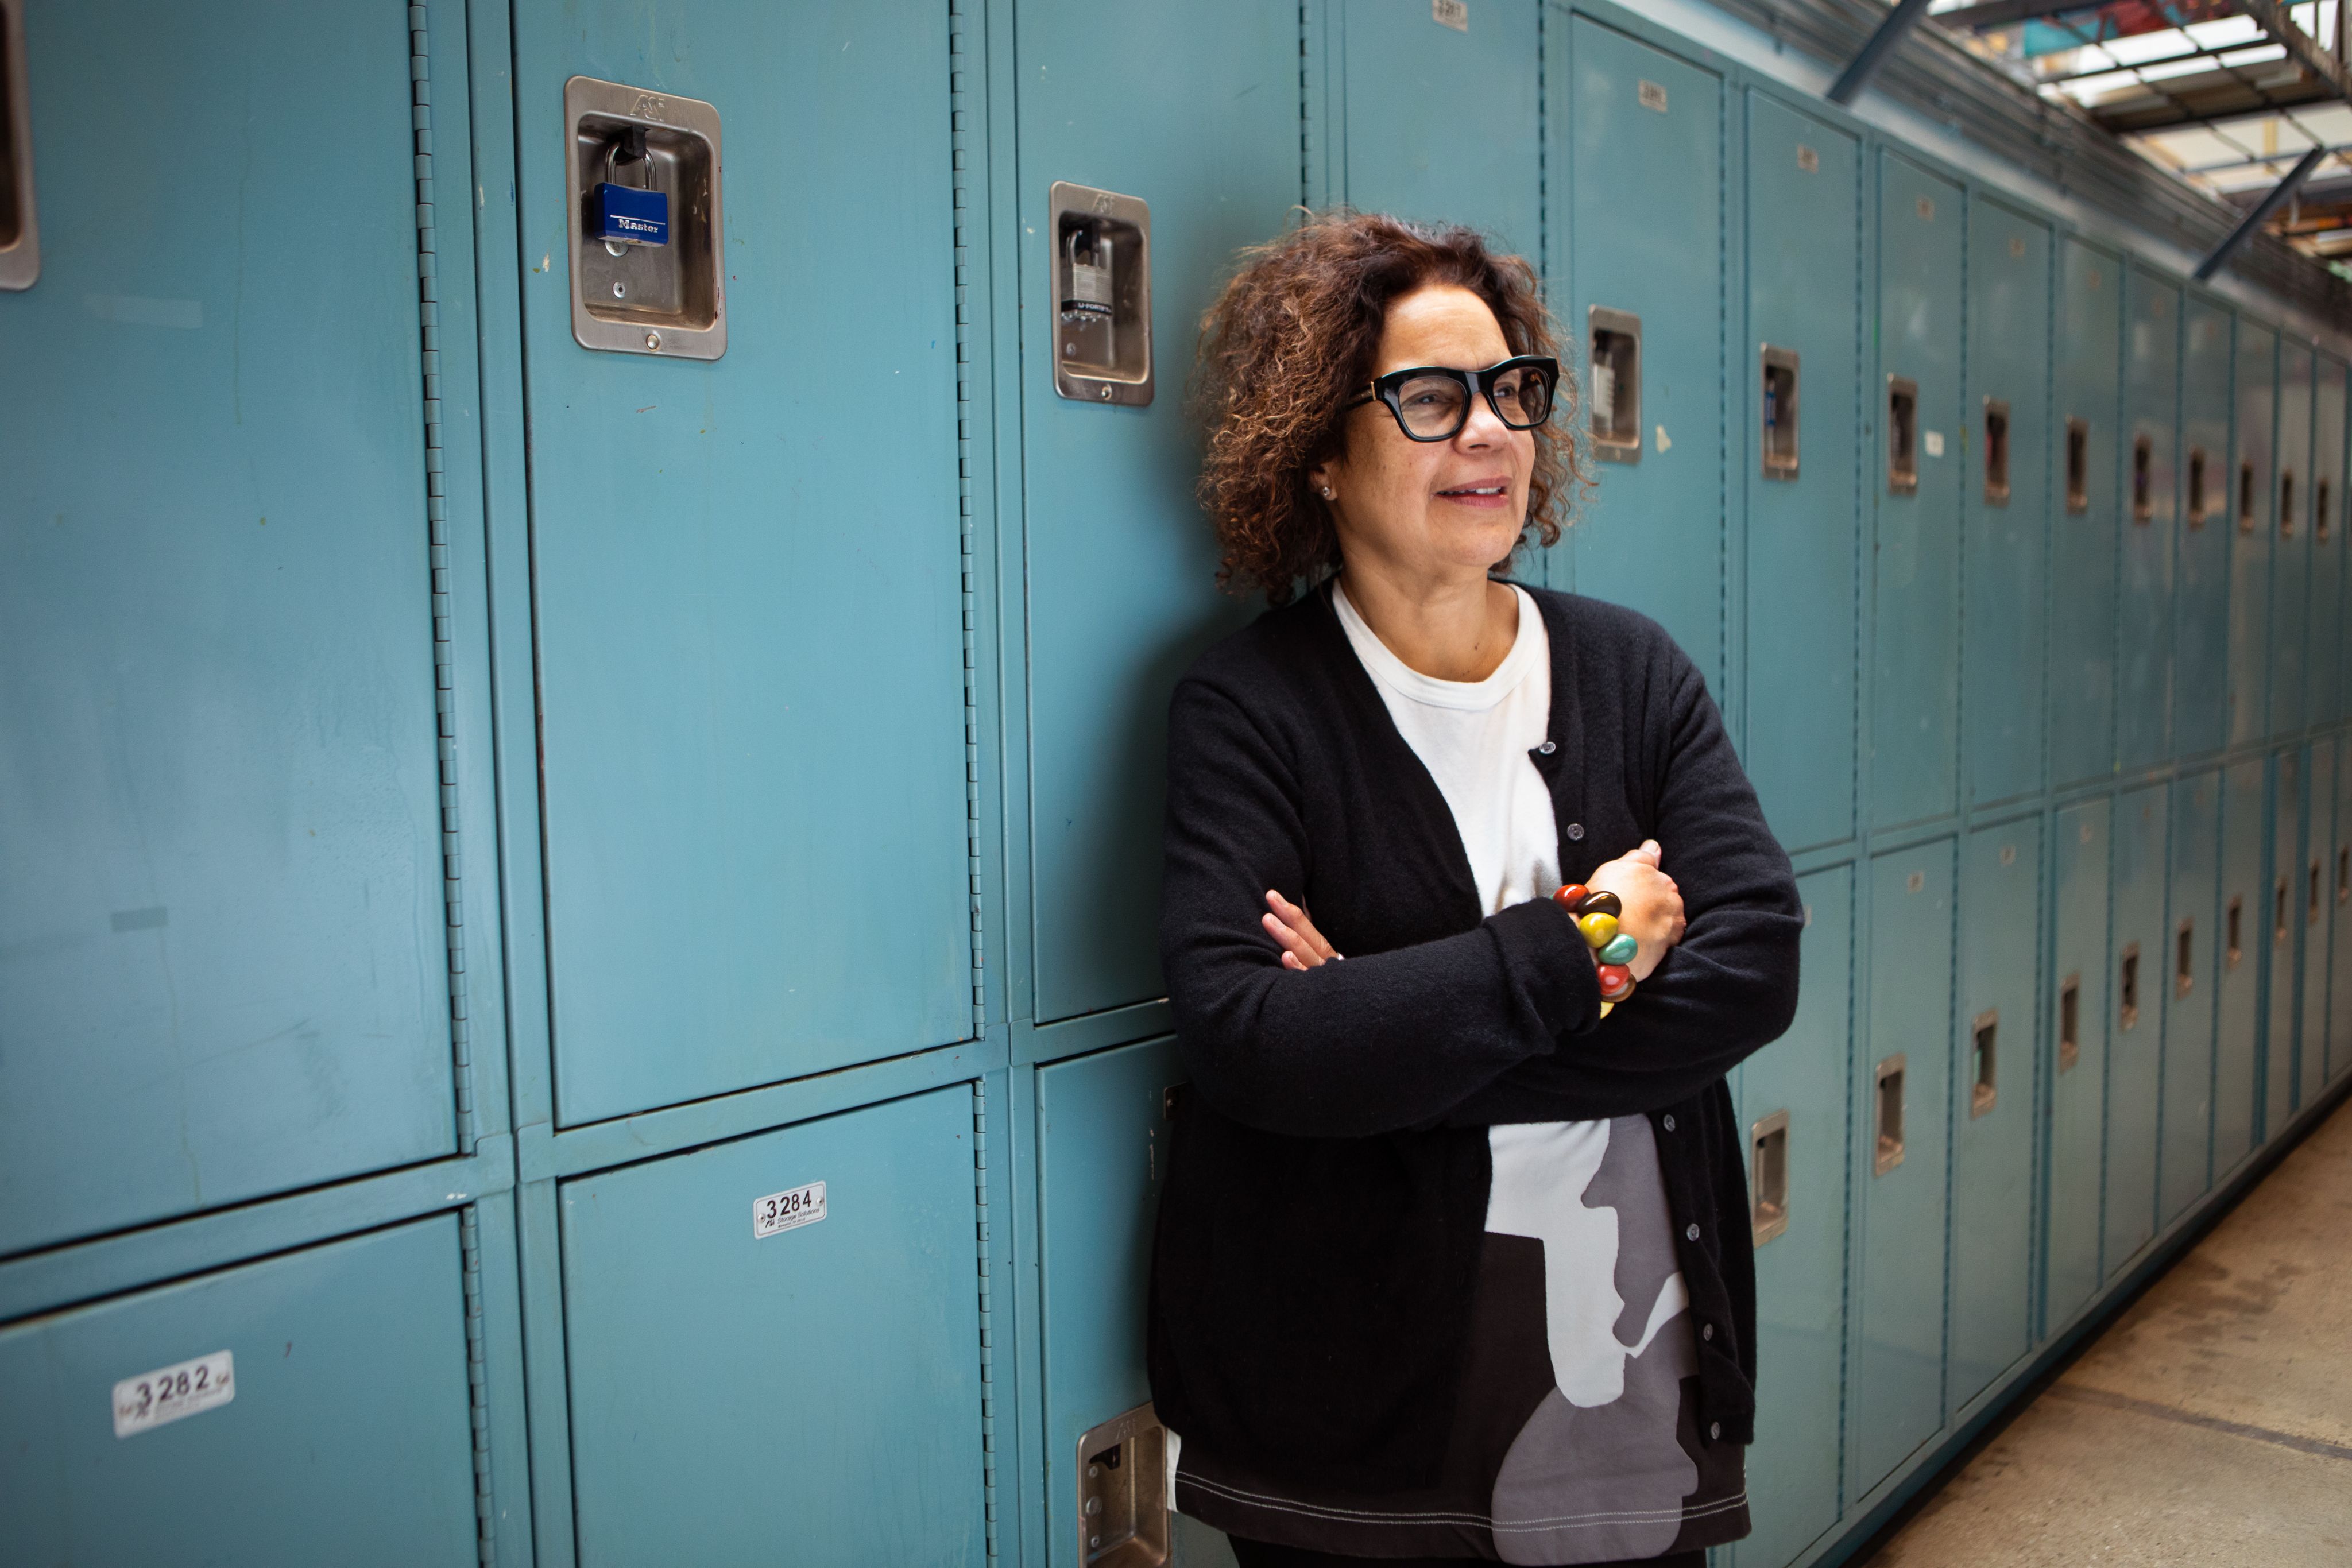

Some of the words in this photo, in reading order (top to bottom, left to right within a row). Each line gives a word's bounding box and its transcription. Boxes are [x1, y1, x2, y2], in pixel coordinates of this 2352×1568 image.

[618, 219, 658, 233] Master
[767, 1189, 812, 1219] 3284
[777, 1214, 797, 1224] Storage
[798, 1208, 820, 1218] Solutions
[136, 1365, 210, 1408] 3282
